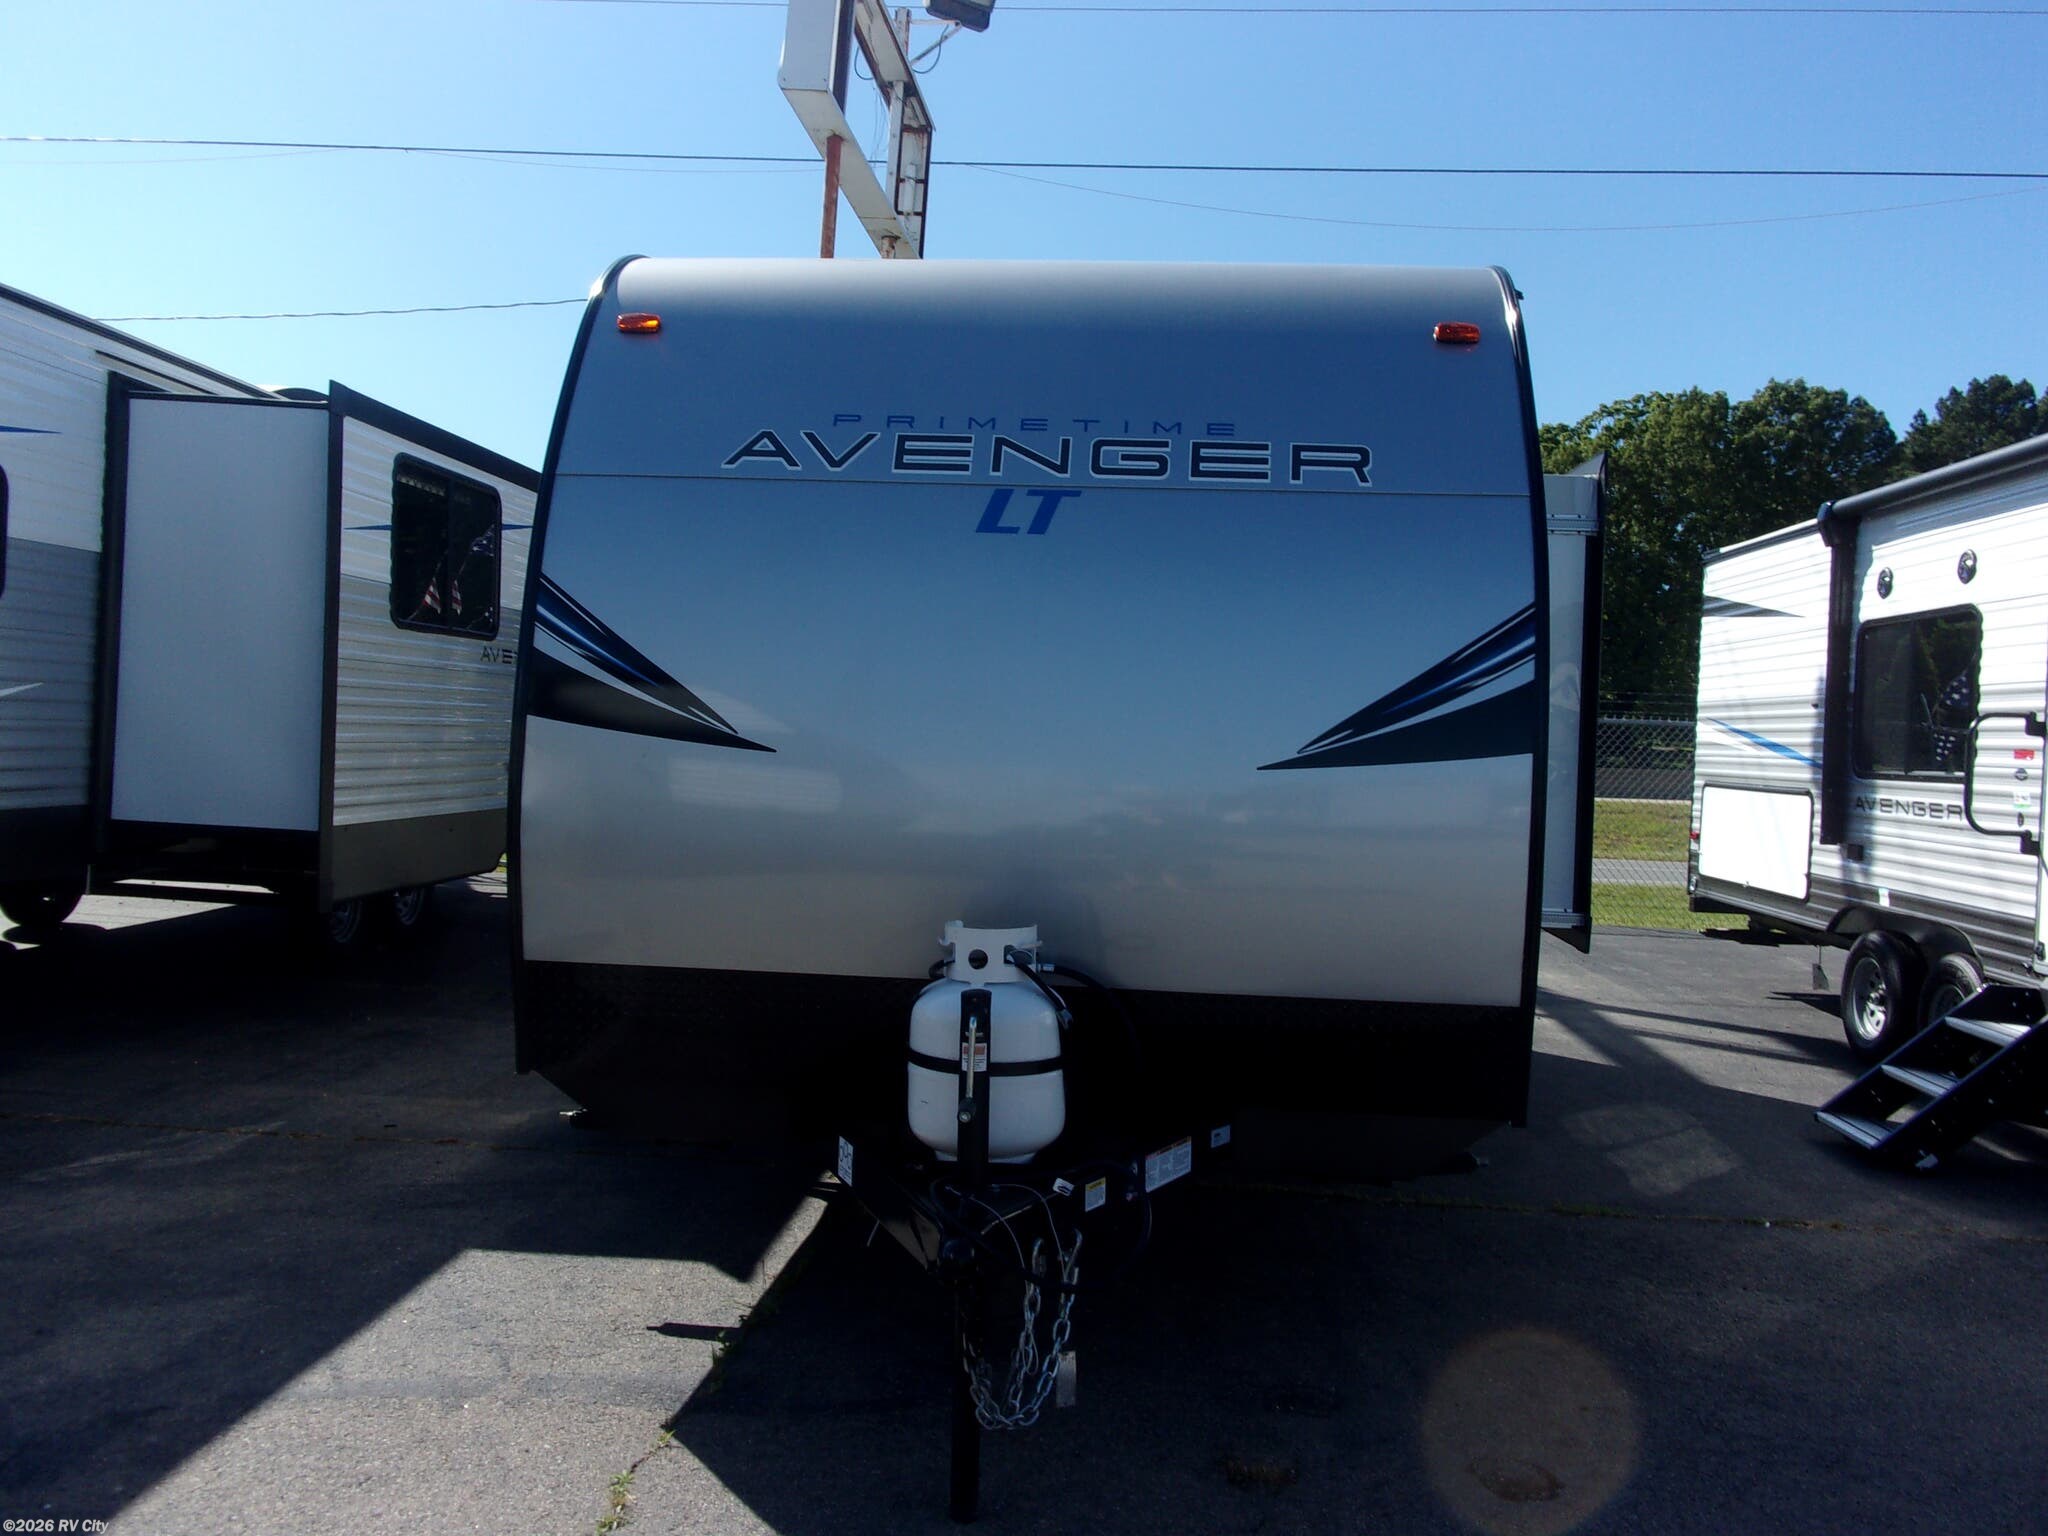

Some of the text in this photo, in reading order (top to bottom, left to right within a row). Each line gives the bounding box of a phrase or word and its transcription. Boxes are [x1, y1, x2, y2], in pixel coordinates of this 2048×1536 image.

[833, 413, 1236, 437] PRIMETIME
[720, 429, 1373, 487] AVENGER
[975, 488, 1083, 535] LT
[480, 645, 518, 665] AVE
[1855, 795, 1963, 821] AVENGER
